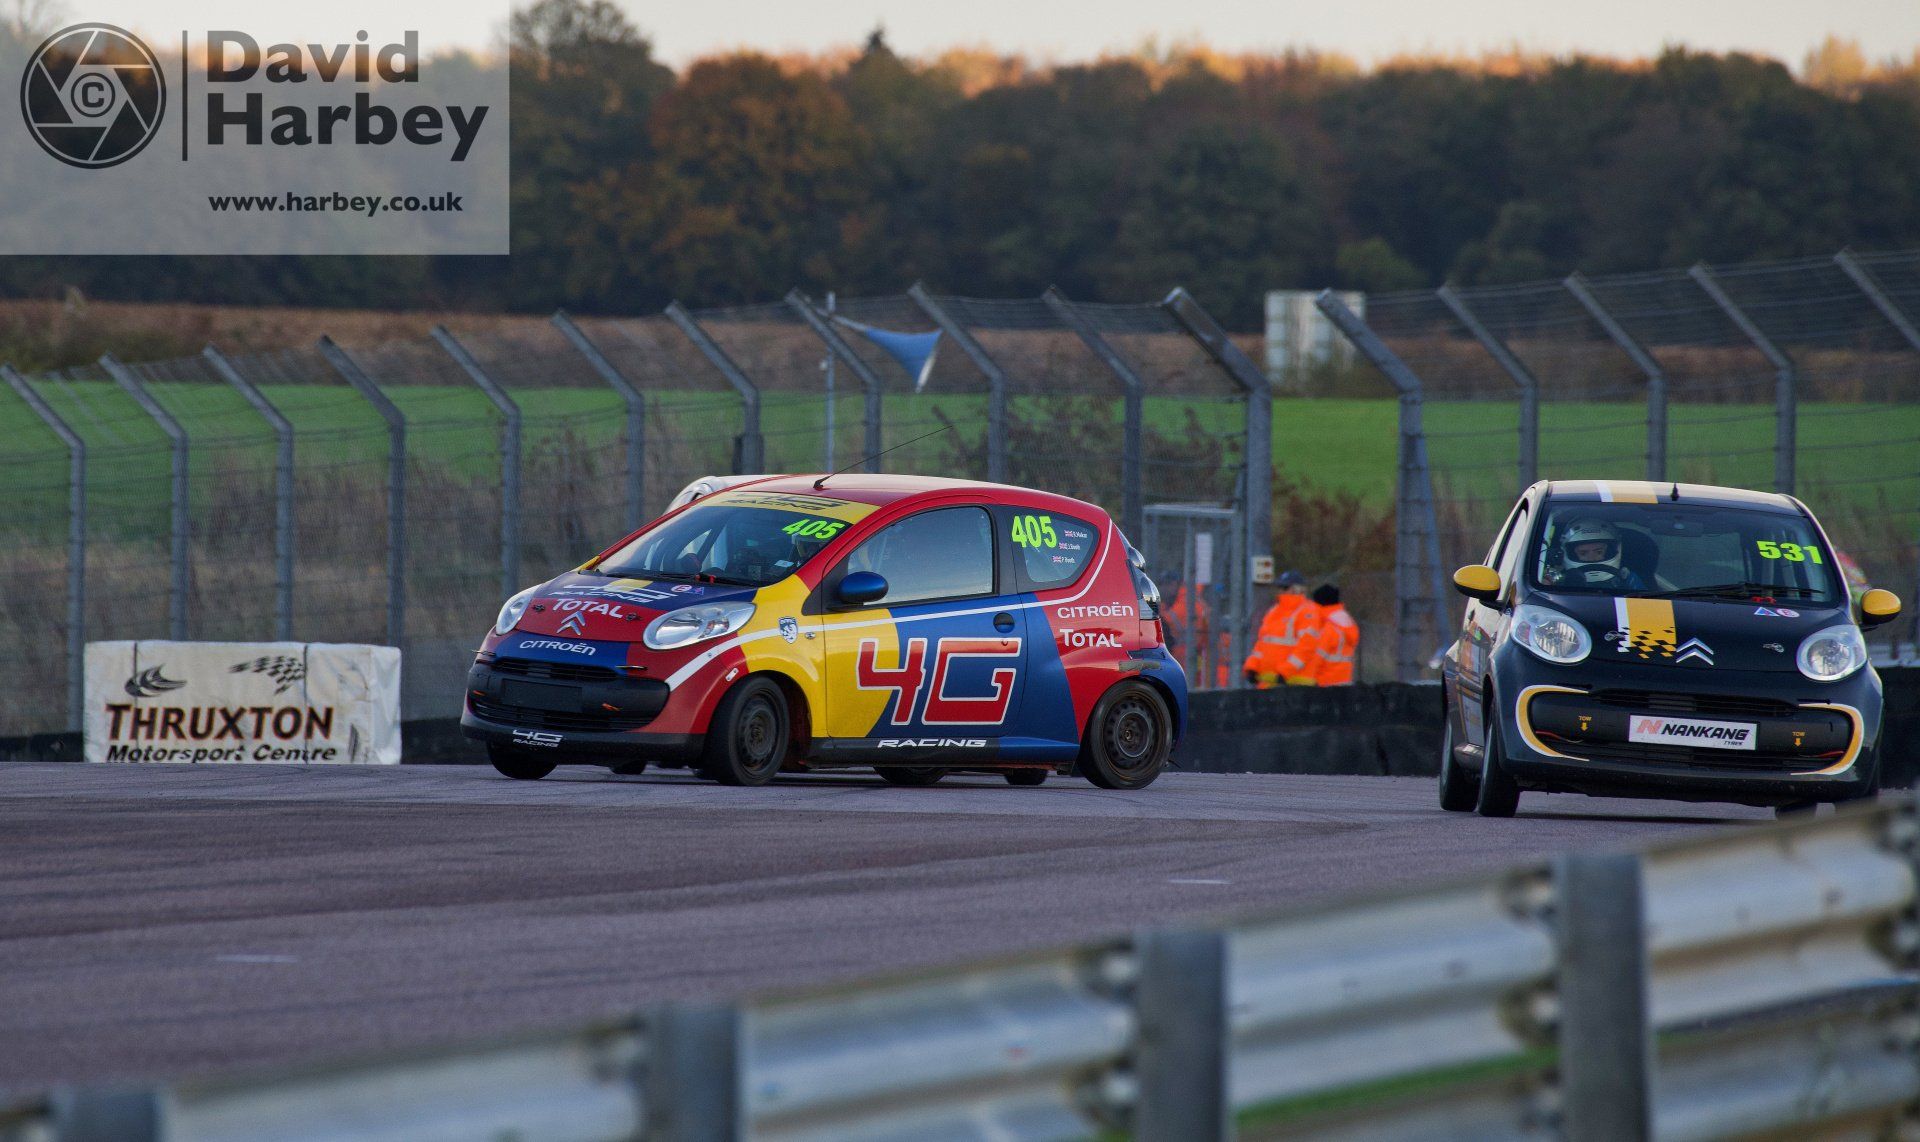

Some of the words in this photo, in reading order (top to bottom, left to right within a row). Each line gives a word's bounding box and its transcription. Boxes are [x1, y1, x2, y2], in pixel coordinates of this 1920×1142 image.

[781, 518, 846, 539] 405
[1011, 515, 1057, 548] 405
[1756, 540, 1823, 565] 531
[552, 598, 625, 619] TOTAL
[1059, 628, 1123, 648] TOTAL
[856, 637, 1022, 726] 4G
[105, 702, 335, 741] THRUXTON
[1661, 722, 1750, 741] NANKANG
[512, 729, 564, 743] 4G
[512, 738, 559, 748] RACING
[877, 739, 987, 748] RACING
[106, 744, 244, 763] Motorsport
[252, 744, 337, 761] Centre
